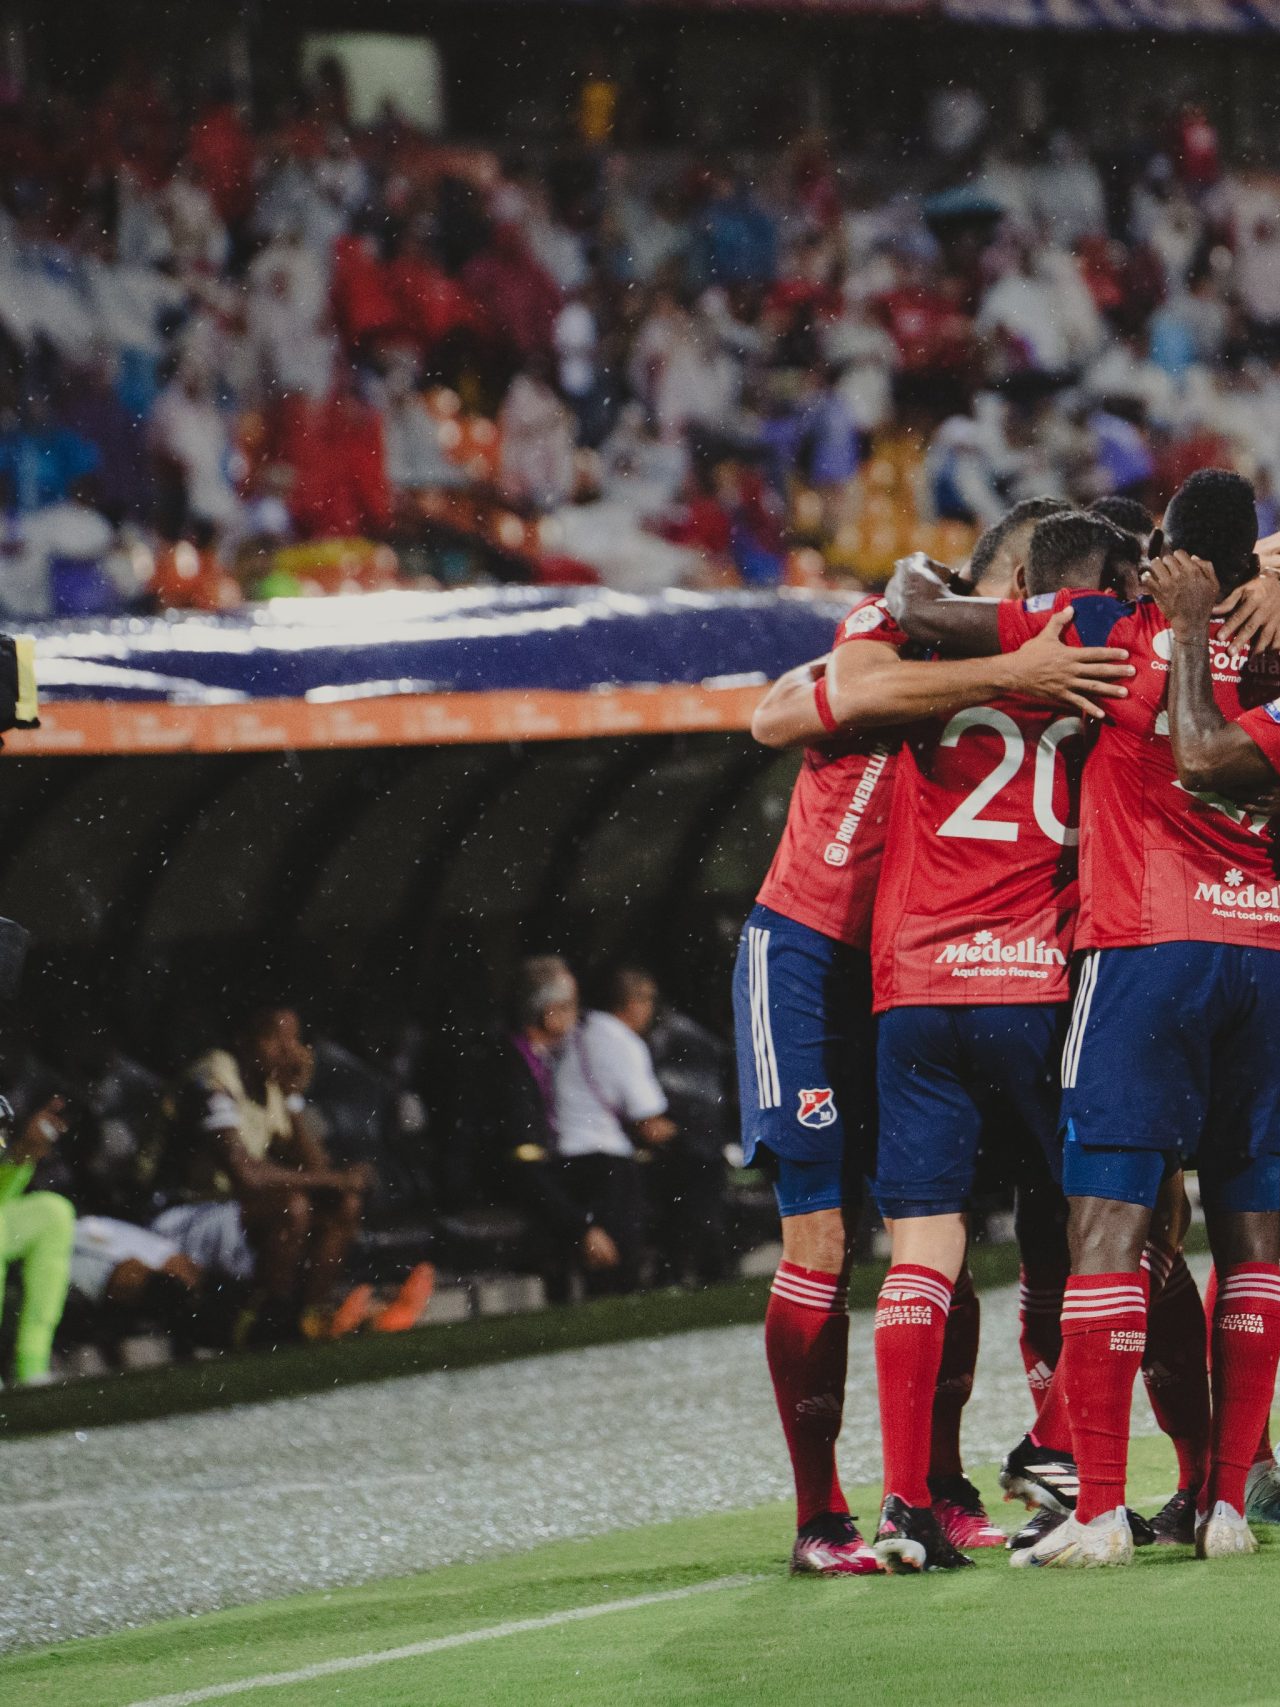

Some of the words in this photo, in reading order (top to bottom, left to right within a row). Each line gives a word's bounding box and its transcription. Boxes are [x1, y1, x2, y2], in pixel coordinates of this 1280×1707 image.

[835, 811, 862, 844] RON
[1237, 910, 1263, 921] todo
[934, 936, 1068, 966] Medellín
[980, 967, 1007, 977] todo
